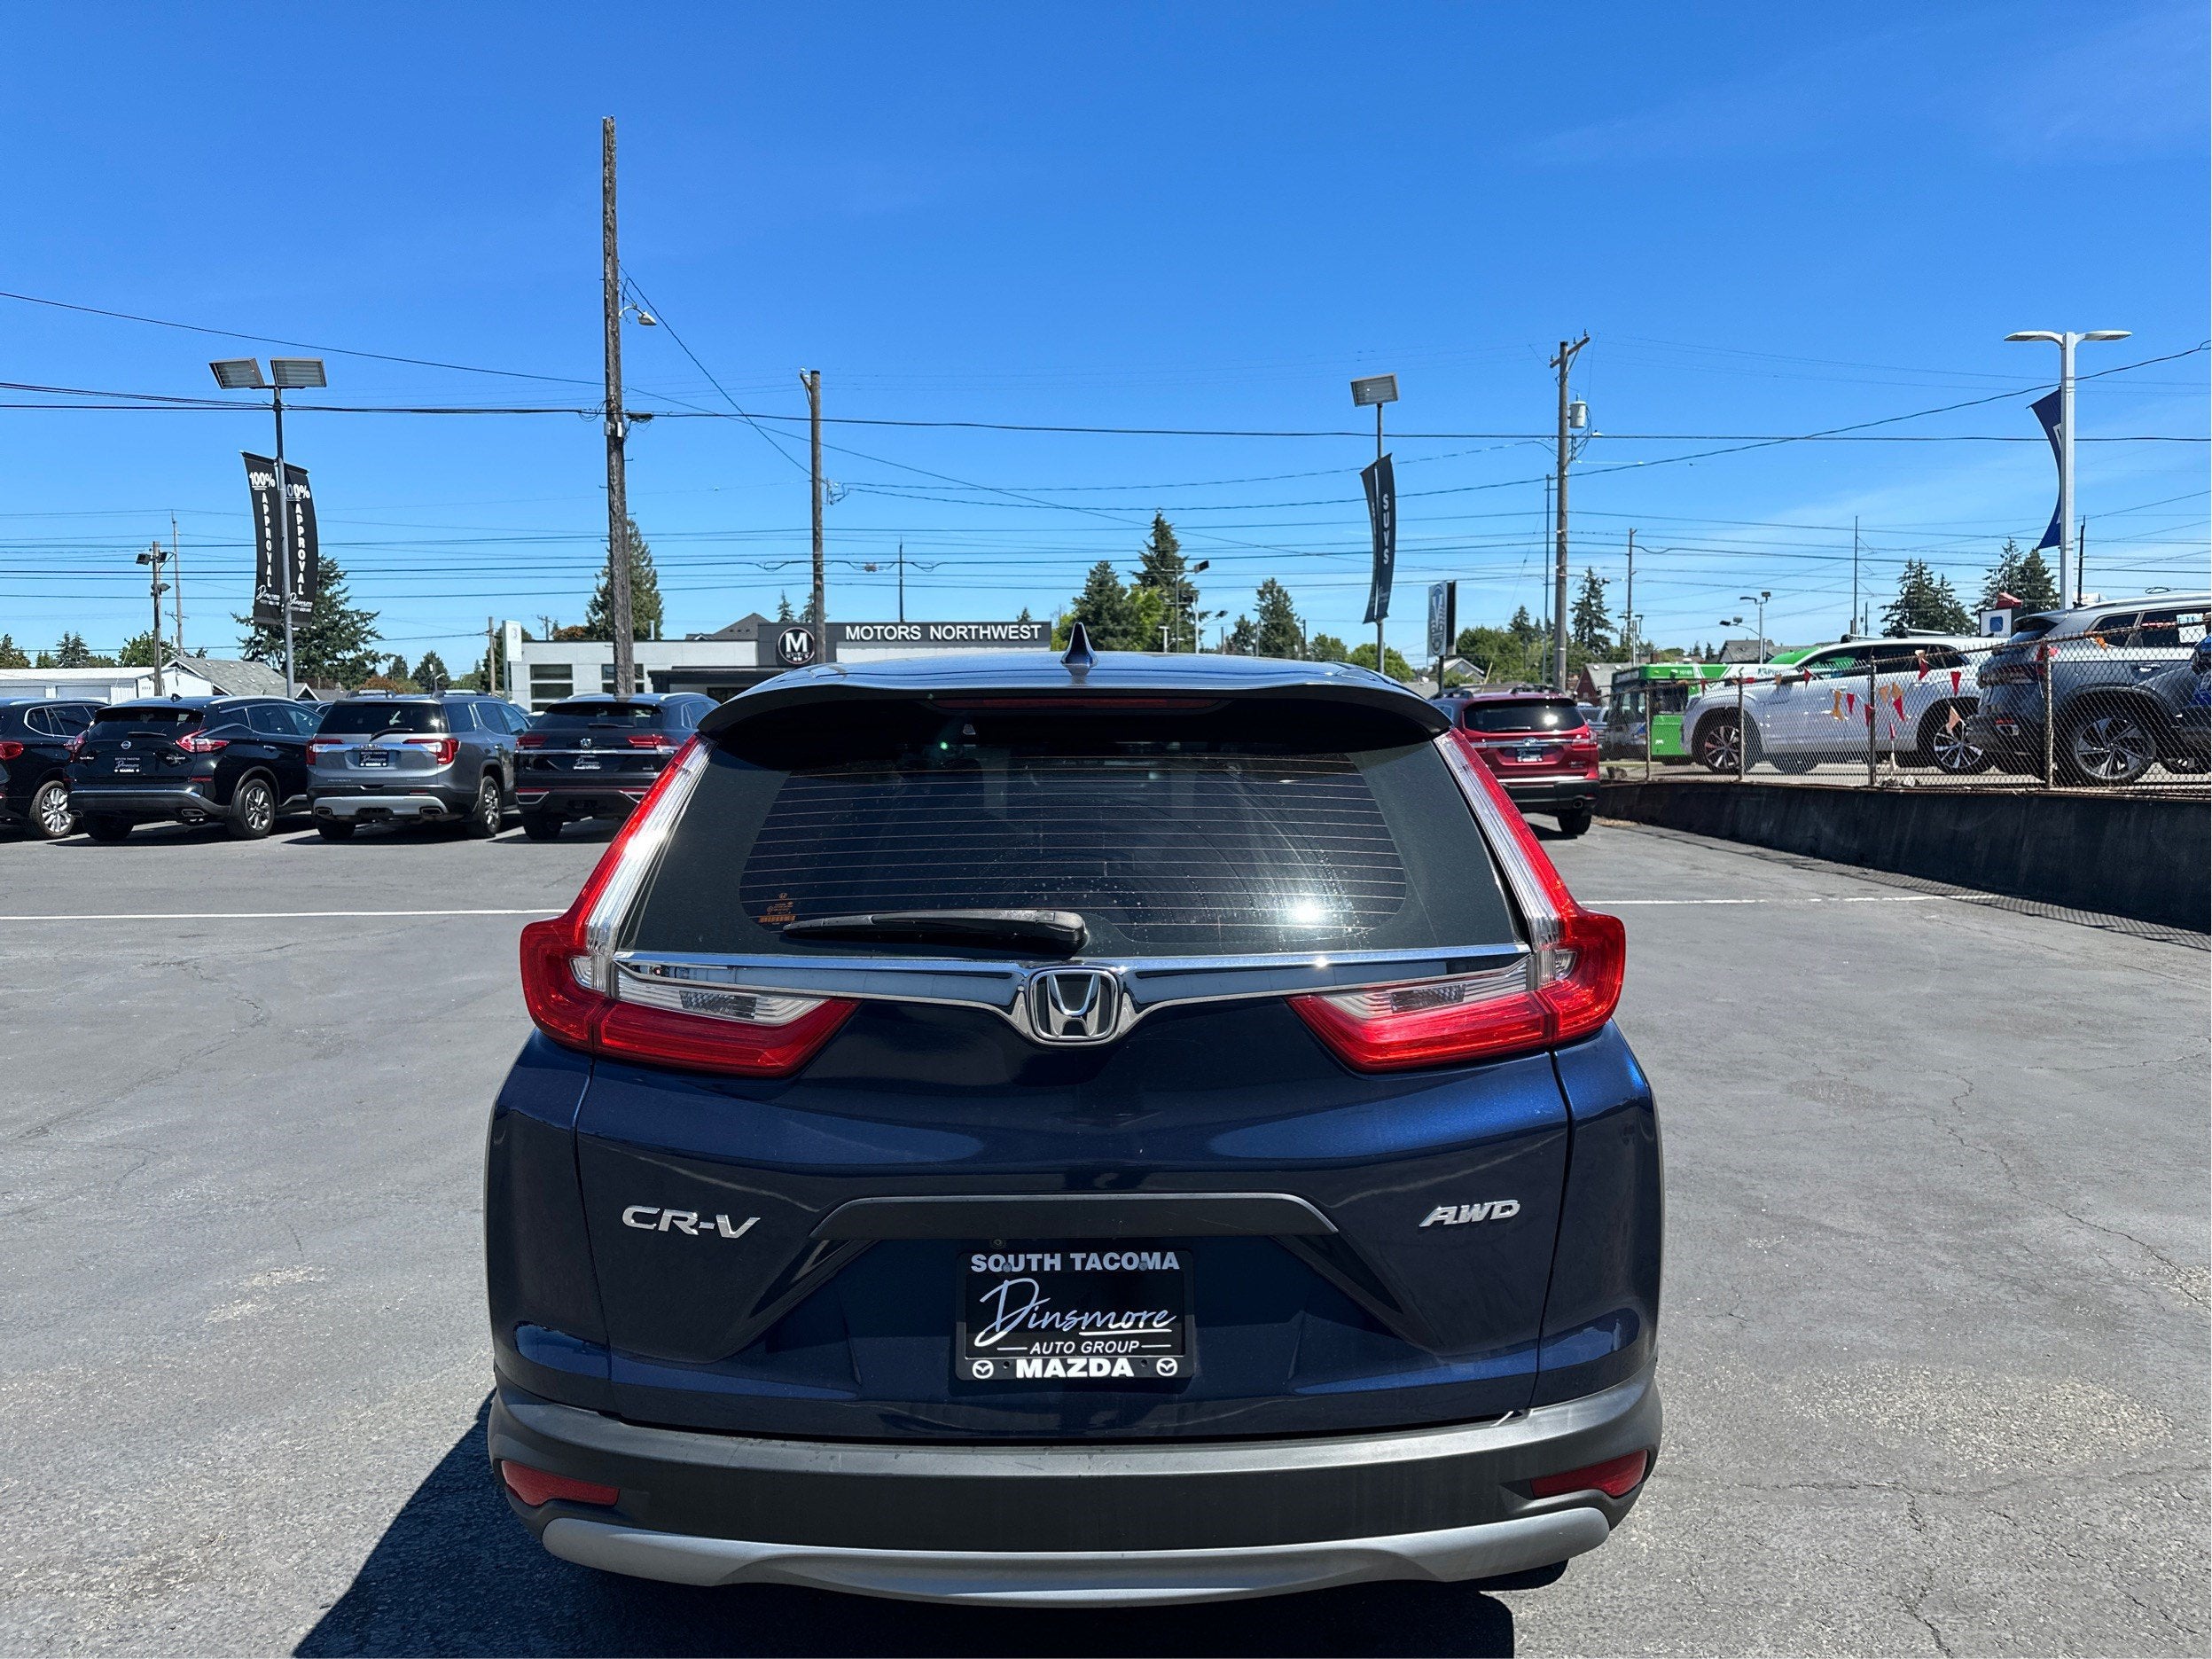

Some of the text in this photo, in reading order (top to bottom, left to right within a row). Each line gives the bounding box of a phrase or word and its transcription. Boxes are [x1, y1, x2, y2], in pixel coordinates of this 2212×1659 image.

[249, 472, 276, 488] 100%
[285, 483, 311, 499] 00%
[262, 491, 272, 588] APPROVAL
[295, 503, 306, 596] APPROVAL
[846, 624, 1042, 641] MOTORS NORTHWEST
[622, 1204, 761, 1239] CR-V
[1419, 1199, 1520, 1228] AWD
[971, 1251, 1180, 1272] SOUTH TACOMA
[974, 1278, 1177, 1347] Dinsmore
[1029, 1340, 1140, 1355] AUTO GROUP
[1015, 1358, 1135, 1379] MAZDA
